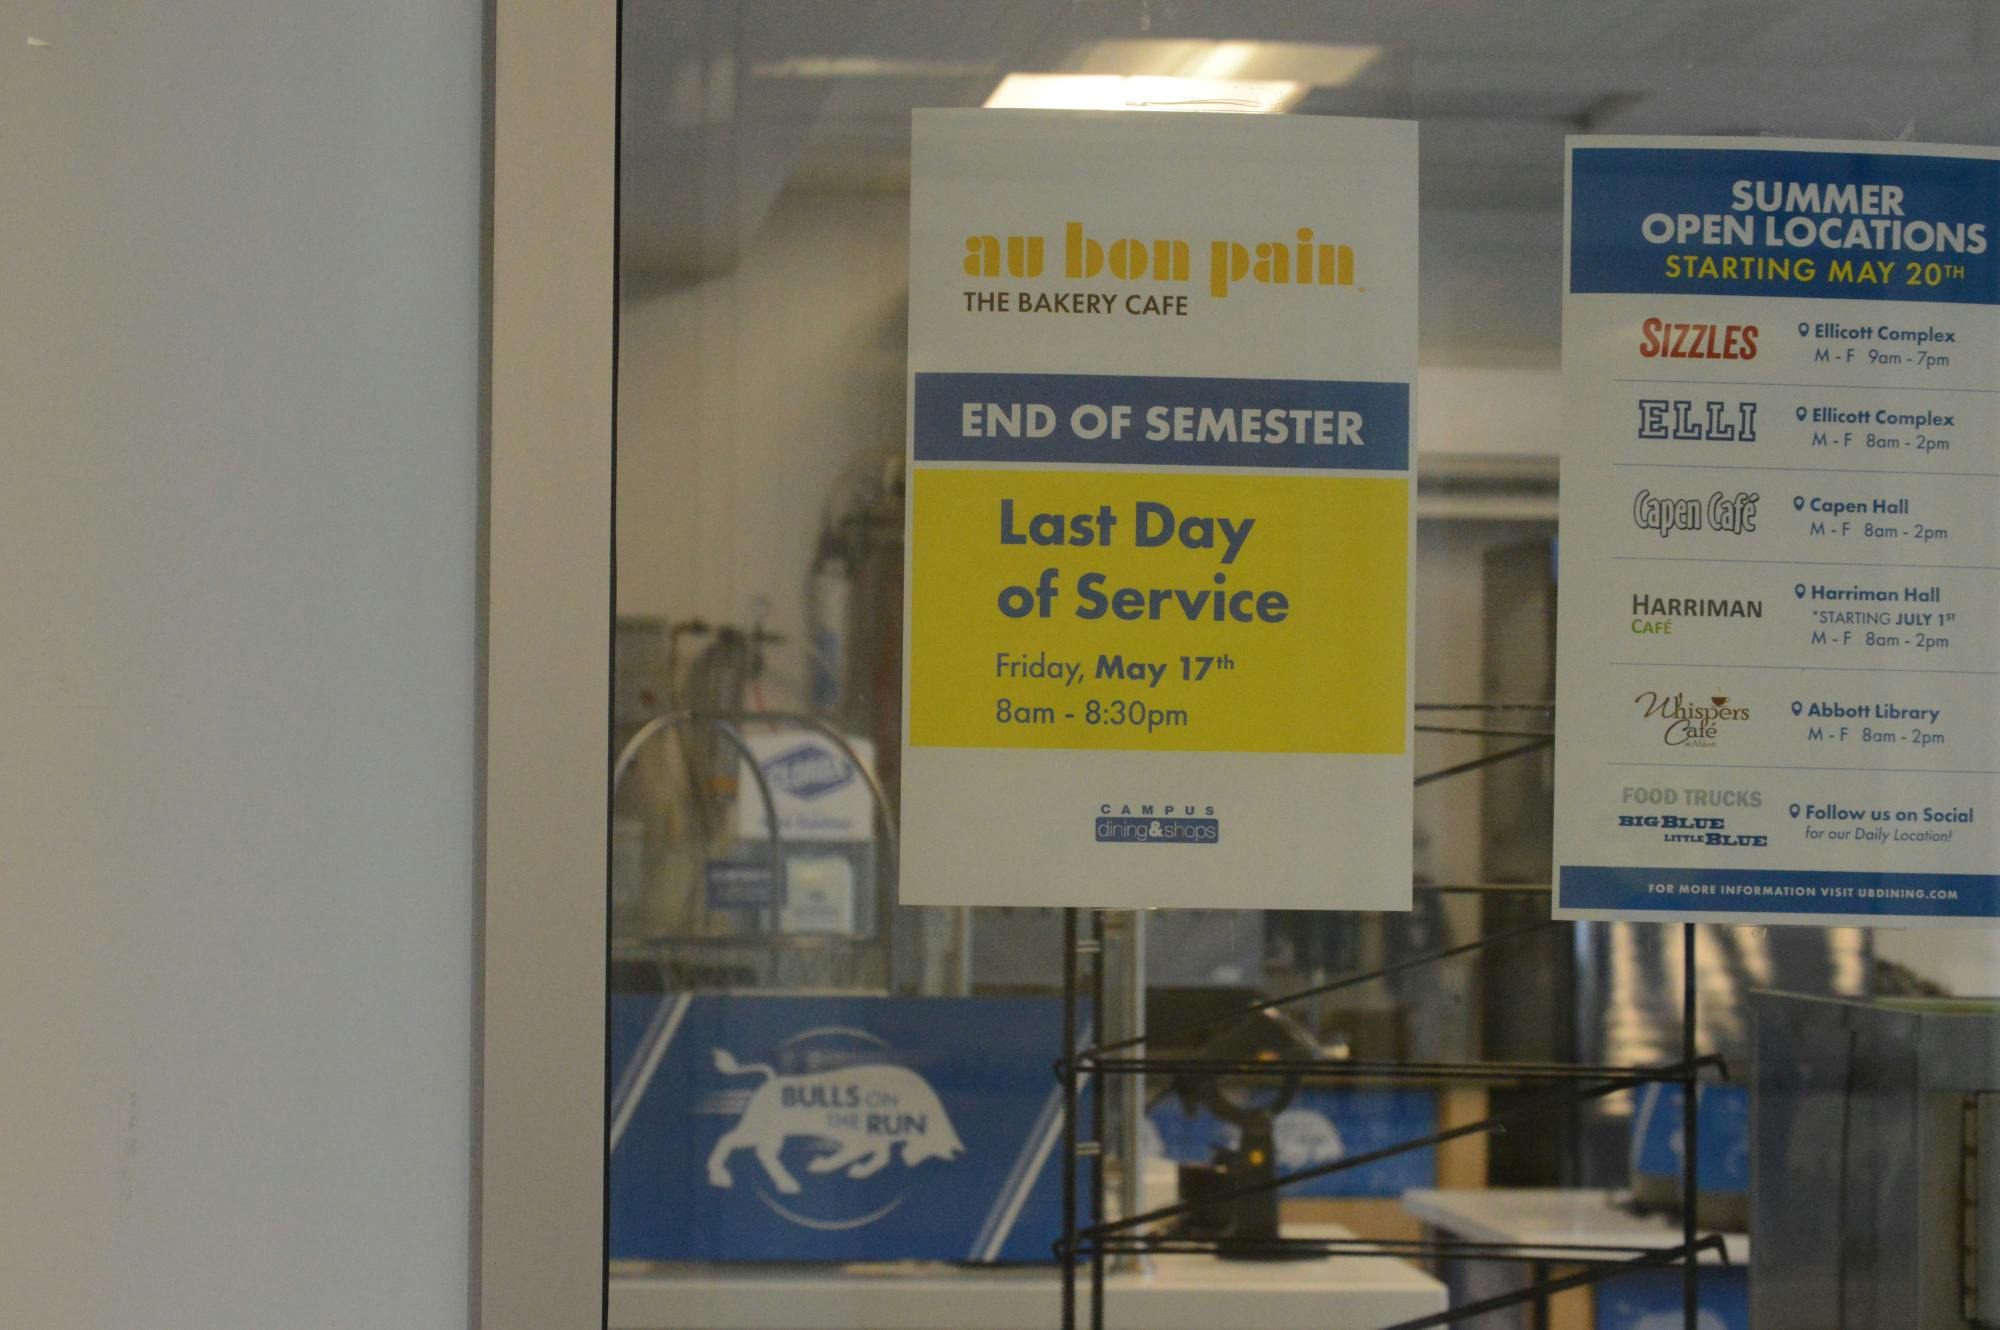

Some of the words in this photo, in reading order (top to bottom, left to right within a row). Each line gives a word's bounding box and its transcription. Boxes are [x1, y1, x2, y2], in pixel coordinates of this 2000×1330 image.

[1732, 180, 1904, 216] SUMMER
[1641, 213, 1755, 245] OPEN
[1766, 216, 1987, 254] LOCATIONS
[963, 235, 1044, 279] au
[1066, 222, 1189, 281] bon
[1211, 227, 1355, 298] pain
[1666, 256, 1815, 280] STARTING
[1828, 260, 1895, 285] MAY
[963, 292, 1009, 312] THE
[1019, 293, 1118, 314] BAKERY
[1126, 295, 1188, 316] CAFE
[1640, 317, 1759, 360] SIZZLES
[1815, 323, 1873, 341] Ellicott
[1878, 326, 1956, 344] Complex
[1867, 350, 1902, 365] 9am
[1917, 351, 1949, 368] 7pm
[962, 403, 1056, 439] END
[1071, 404, 1131, 440] OF
[1146, 406, 1365, 445] SEMESTER
[1639, 400, 1757, 442] ELLI
[1813, 408, 1872, 425] Ellicott
[1876, 410, 1954, 428] Complex
[1866, 434, 1900, 449] 8am
[1916, 435, 1950, 451] 2pm
[1634, 489, 1702, 537] Capen
[1707, 491, 1759, 533] Café
[1810, 499, 1867, 517] Capen
[1872, 499, 1908, 514] Hall
[1001, 499, 1117, 546] Last
[1136, 502, 1255, 563] Day
[1864, 524, 1898, 538] 8am
[1914, 525, 1947, 541] 2pm
[998, 568, 1059, 618] of
[1076, 573, 1289, 622] Service
[1812, 585, 1899, 602] Harriman
[1904, 588, 1940, 602] Hall
[1632, 594, 1763, 618] HARRIMAN
[1632, 618, 1672, 634] CAFÉ
[1895, 612, 1932, 625] JULY
[1866, 633, 1899, 647] 8am
[1916, 634, 1949, 650] 2pm
[996, 653, 1085, 685] Friday,
[1095, 655, 1167, 687] May
[996, 699, 1054, 724] 8am
[1085, 701, 1187, 733] 8:30pm
[1635, 692, 1749, 725] Whispers
[1808, 705, 1869, 719] Abbott
[1875, 705, 1941, 723] Library
[1665, 720, 1717, 745] Café
[1862, 729, 1895, 743] 8am
[1911, 730, 1944, 745] 2pm
[1623, 787, 1678, 804] FOOD
[1684, 789, 1762, 807] TRUCKS
[1101, 804, 1214, 815] CAMPUS
[1806, 805, 1864, 821] Follow
[1871, 809, 1890, 822] us
[1896, 809, 1917, 823] on
[1923, 807, 1973, 823] Social
[1619, 815, 1660, 827] BIG
[1661, 816, 1724, 829] BLUE
[1664, 834, 1704, 843] LITTLE
[1705, 833, 1767, 846] BLUE
[1806, 826, 1824, 841] for
[1829, 830, 1851, 841] our
[1855, 827, 1890, 843] Daily
[1894, 828, 1952, 843] Location!
[1649, 884, 1675, 894] FOR
[1679, 885, 1716, 895] MORE
[1720, 885, 1816, 897] INFORMATION
[1820, 887, 1854, 897] VISIT
[1858, 888, 1958, 900] UBDINING.COM
[782, 1085, 859, 1107] BULLS
[866, 1114, 926, 1134] RUN
